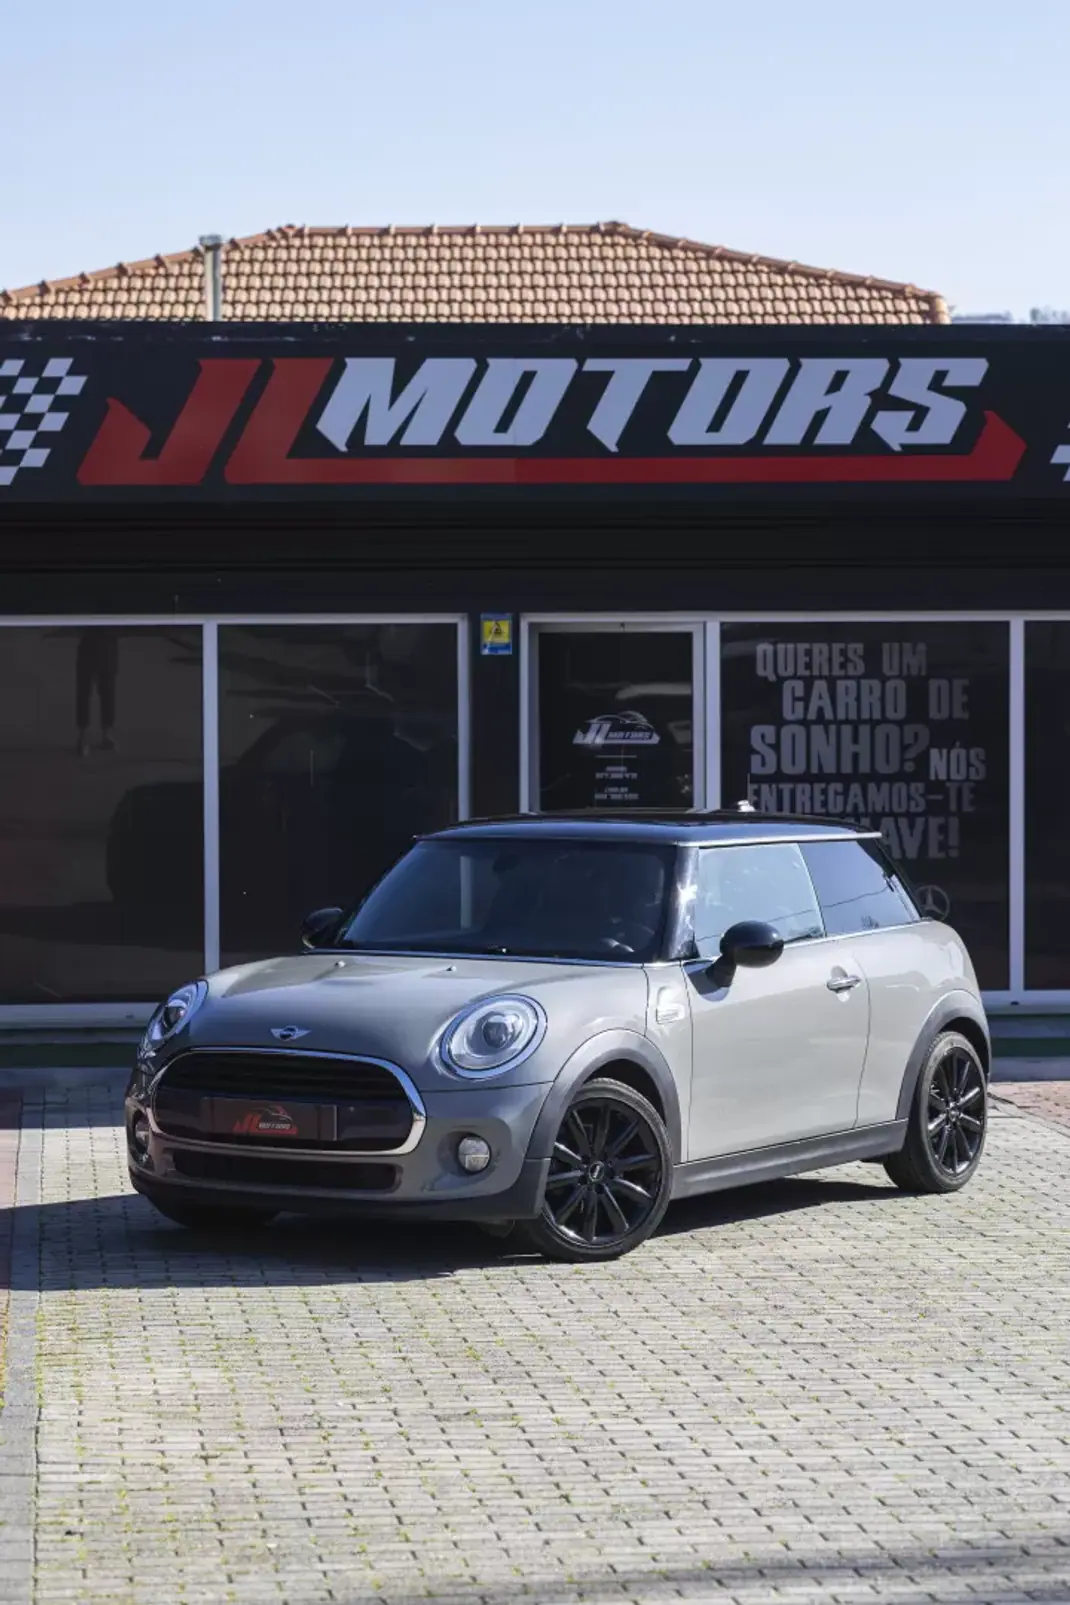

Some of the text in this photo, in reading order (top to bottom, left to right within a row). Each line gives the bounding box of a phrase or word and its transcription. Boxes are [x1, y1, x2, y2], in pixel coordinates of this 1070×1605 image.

[756, 643, 927, 681] QUERES UM
[782, 679, 969, 720] CARRO DE
[750, 724, 930, 774] SONHO?
[929, 741, 986, 781] NÓS
